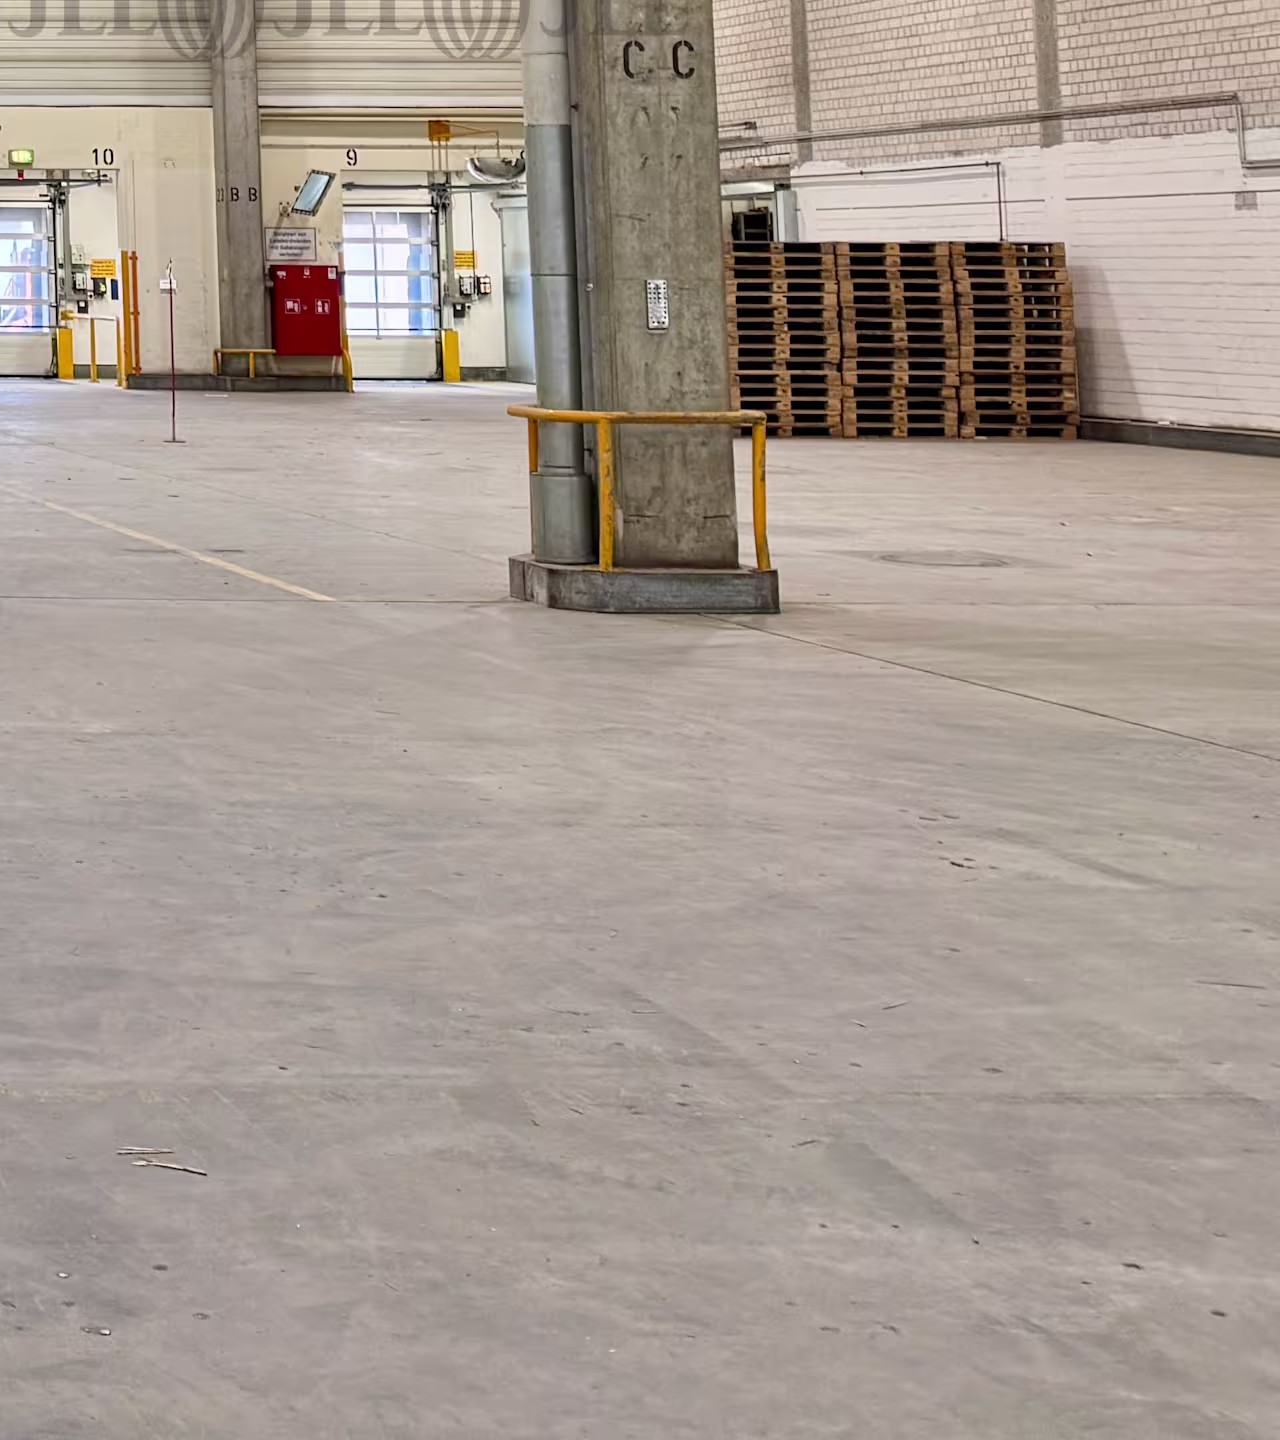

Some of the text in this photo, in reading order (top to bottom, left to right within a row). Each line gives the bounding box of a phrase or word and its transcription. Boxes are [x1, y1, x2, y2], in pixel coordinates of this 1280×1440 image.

[623, 40, 695, 78] C C
[92, 148, 114, 166] 10
[346, 148, 357, 166] 9
[230, 186, 240, 201] B
[248, 186, 258, 201] B
